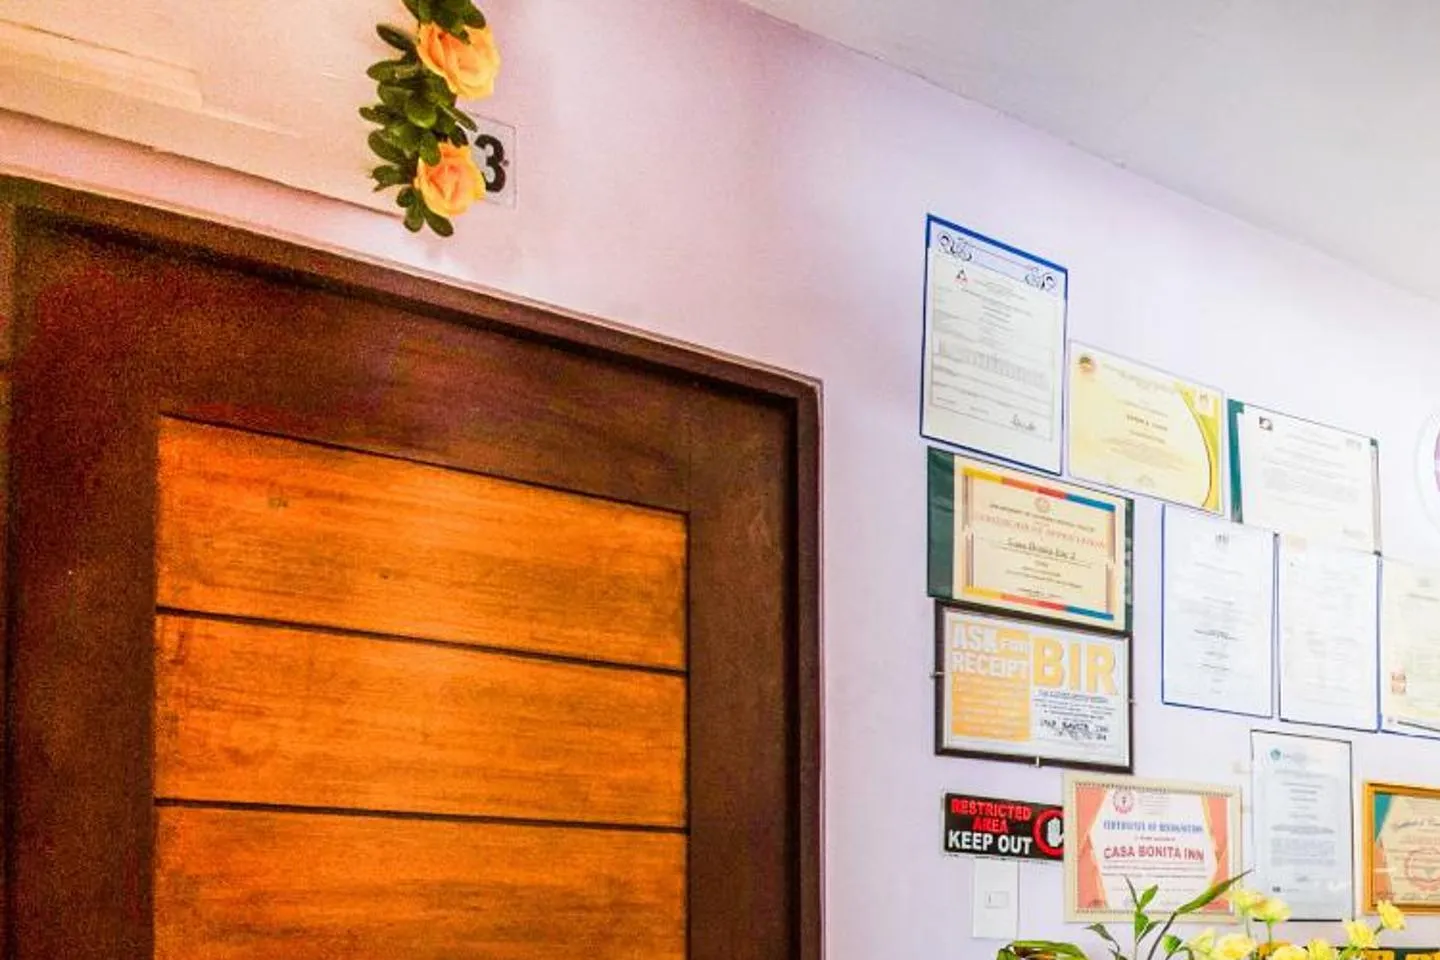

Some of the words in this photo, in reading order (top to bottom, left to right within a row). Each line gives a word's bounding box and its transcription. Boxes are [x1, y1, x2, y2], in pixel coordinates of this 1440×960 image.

[1033, 637, 1119, 695] BIR
[951, 798, 1033, 821] RESTRICTED
[972, 816, 1009, 833] AREA
[948, 829, 993, 851] KEEP
[997, 834, 1033, 855] OUT
[1103, 845, 1135, 859] CASA
[1138, 845, 1181, 859] BONITA
[1184, 847, 1205, 861] INN
